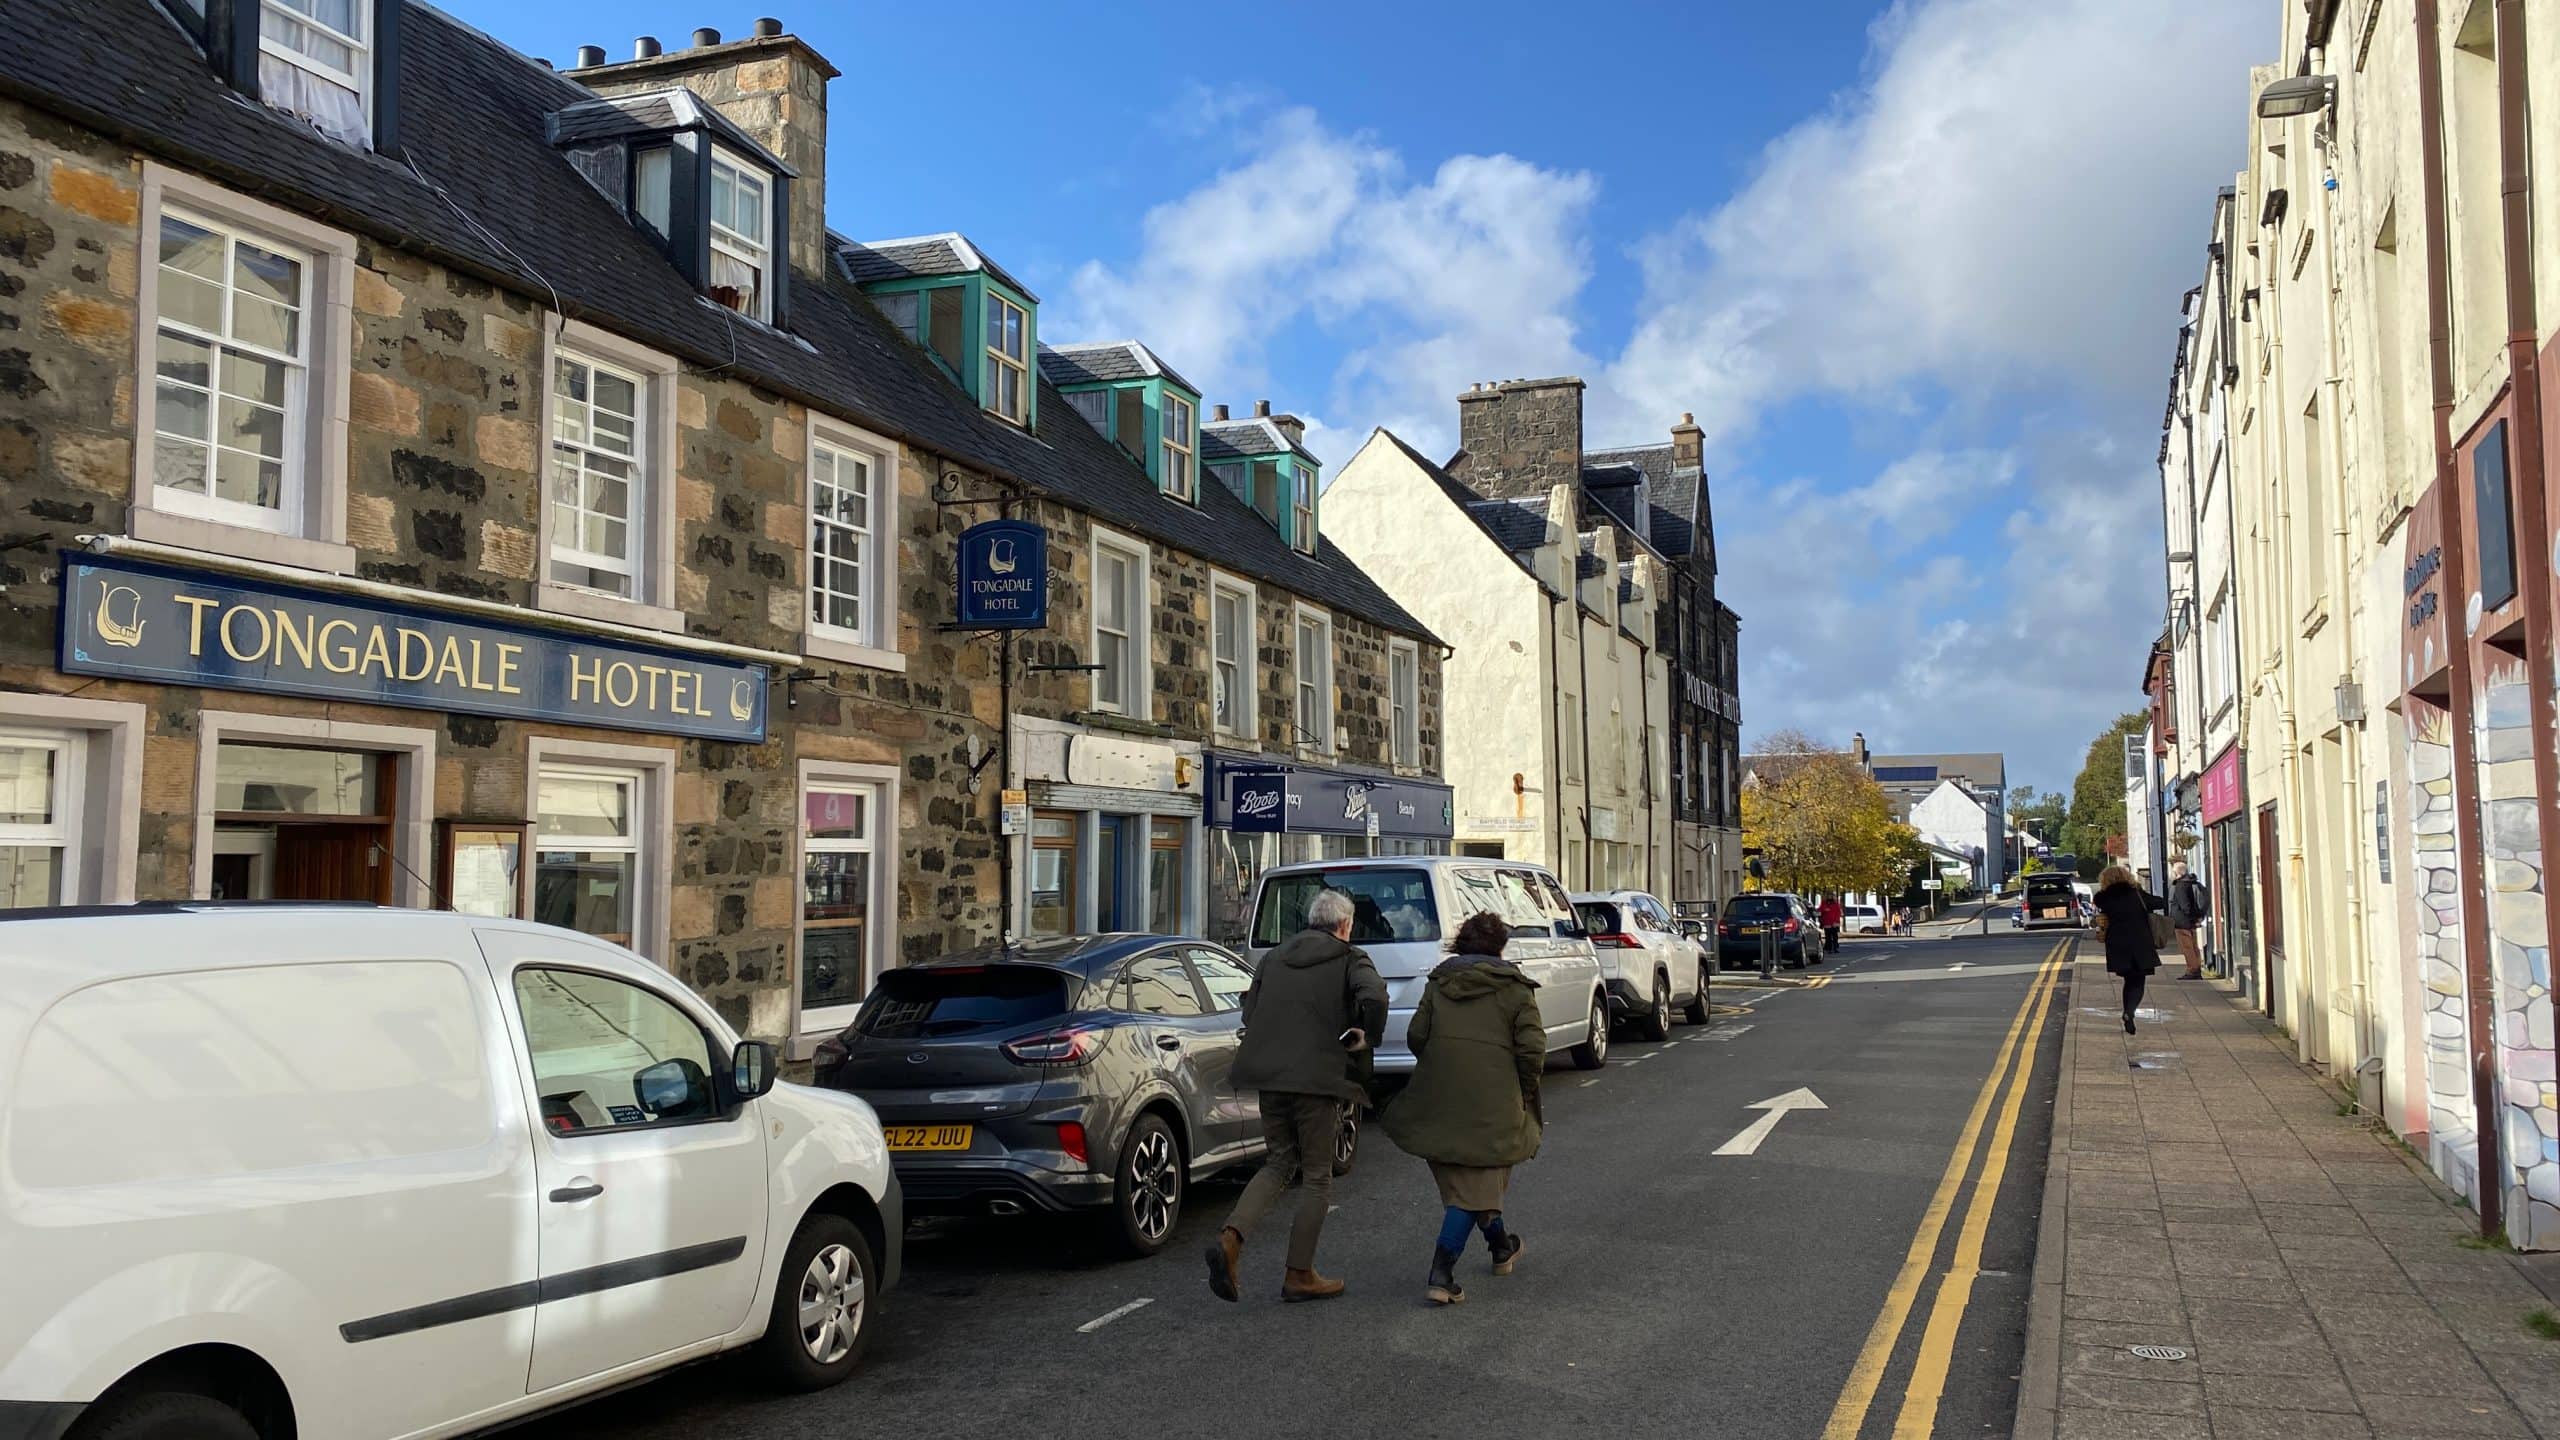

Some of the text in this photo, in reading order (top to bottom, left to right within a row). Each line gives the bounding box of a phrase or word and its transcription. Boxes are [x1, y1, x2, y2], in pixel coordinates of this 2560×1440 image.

[970, 579, 1032, 592] TONGADALE
[984, 599, 1020, 610] HOTEL
[174, 594, 712, 717] TONGADALE HOTEL
[1686, 671, 1721, 715] PORTREE
[1237, 790, 1280, 814] Boots
[1398, 800, 1415, 819] Beauty
[883, 1127, 966, 1147] GL22 JUU
